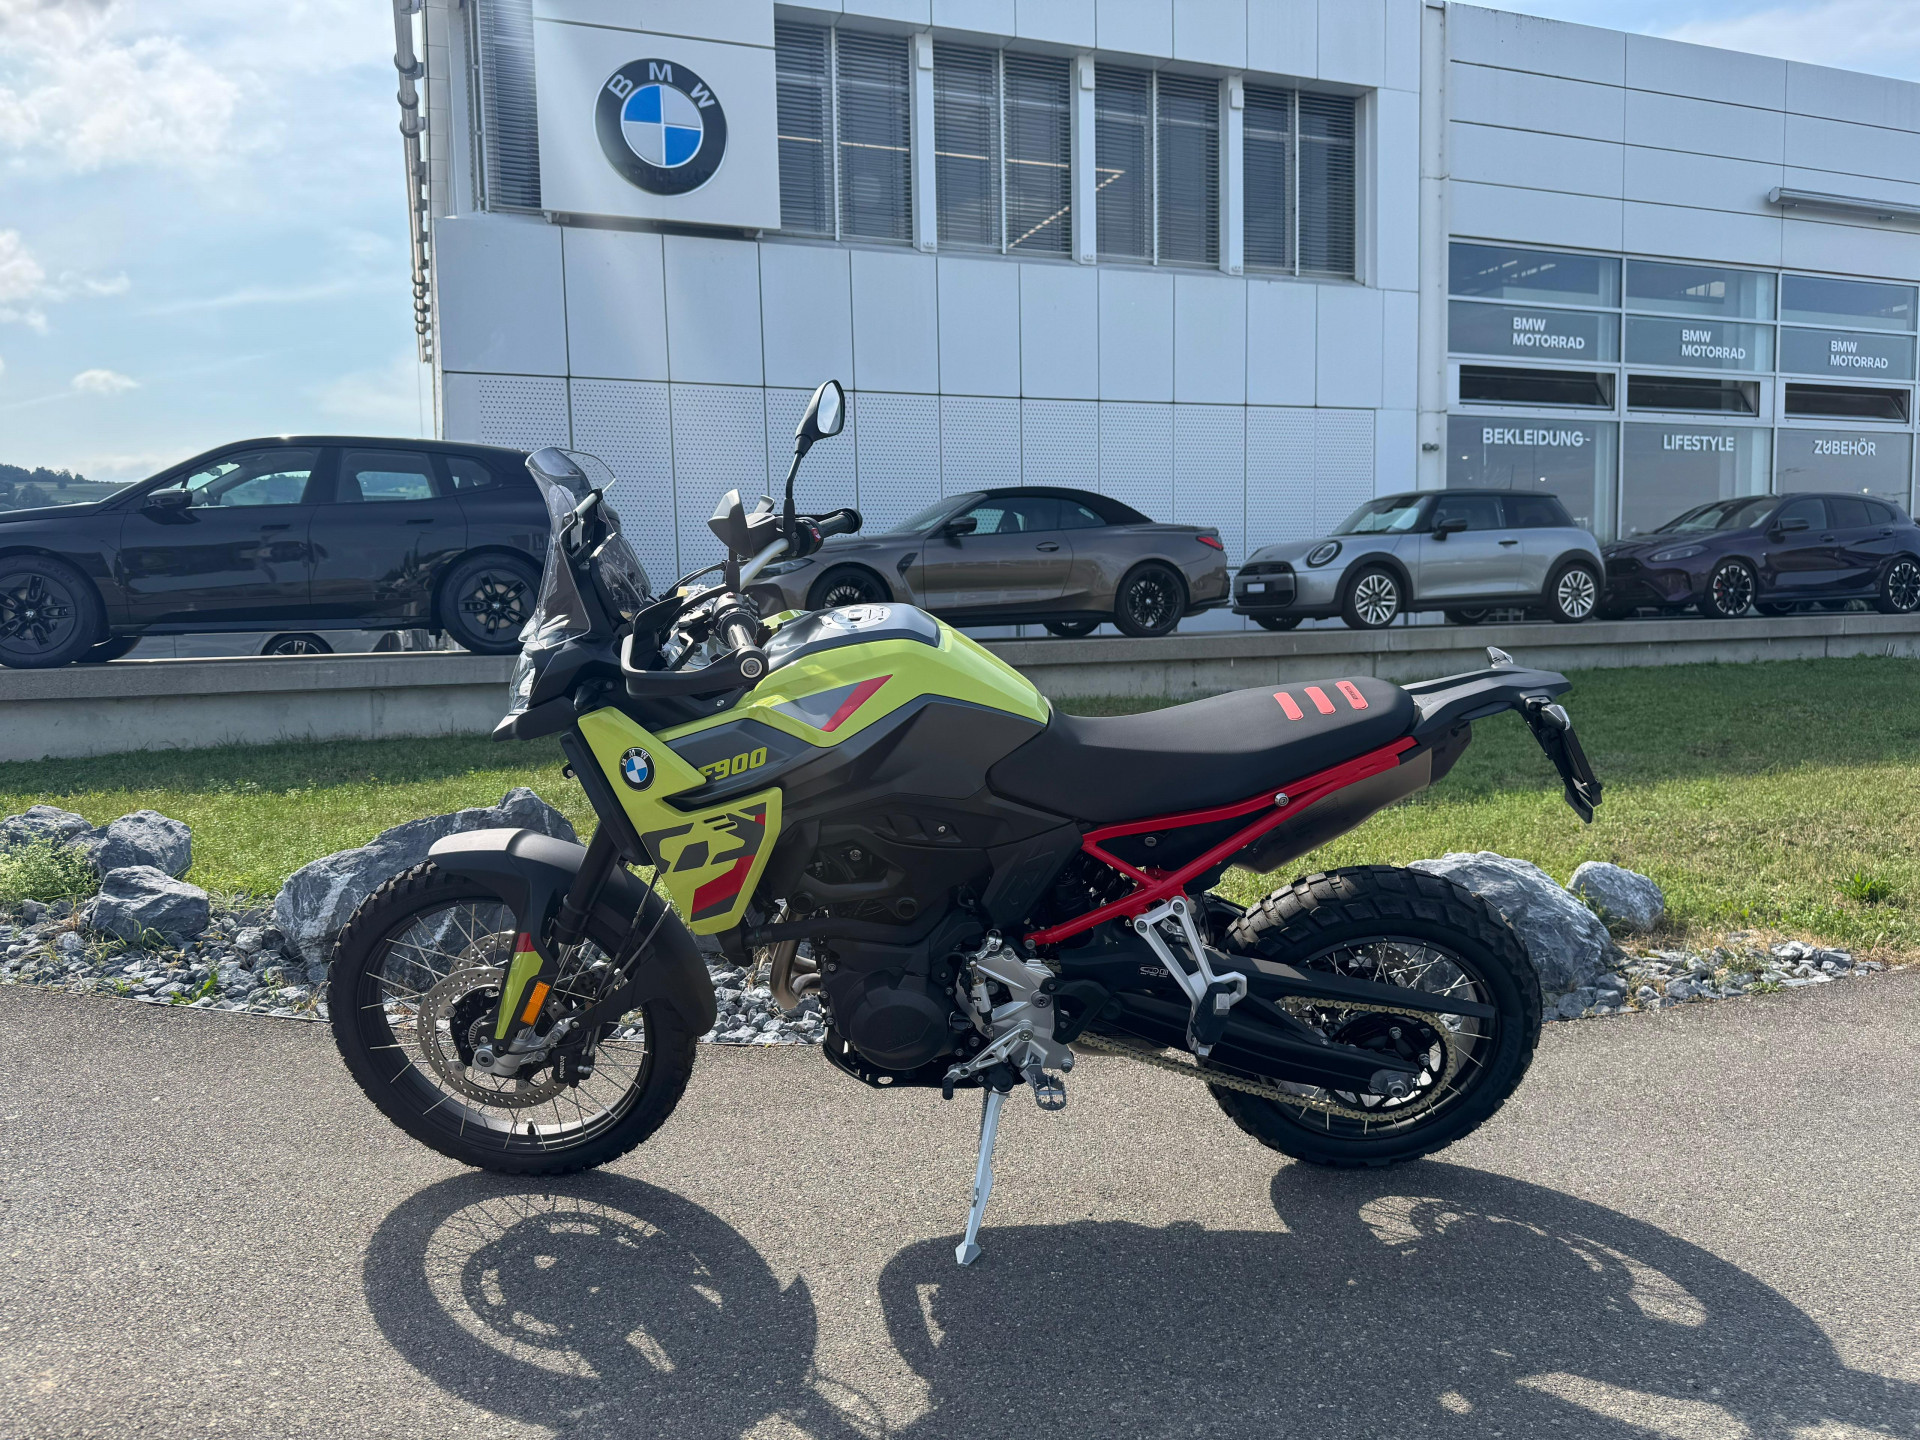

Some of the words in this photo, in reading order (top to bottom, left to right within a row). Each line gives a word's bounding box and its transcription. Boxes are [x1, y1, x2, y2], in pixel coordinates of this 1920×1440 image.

[607, 62, 715, 109] BMW
[1513, 317, 1546, 332] BMW
[1512, 333, 1585, 349] MOTORRAD
[1681, 329, 1711, 343] BMW
[1681, 344, 1746, 360] MOTORRAD
[1830, 340, 1857, 353] BMW
[1830, 354, 1889, 369] MOTORRAD
[1663, 434, 1735, 452] LIFESTYLE
[621, 749, 649, 767] BMW
